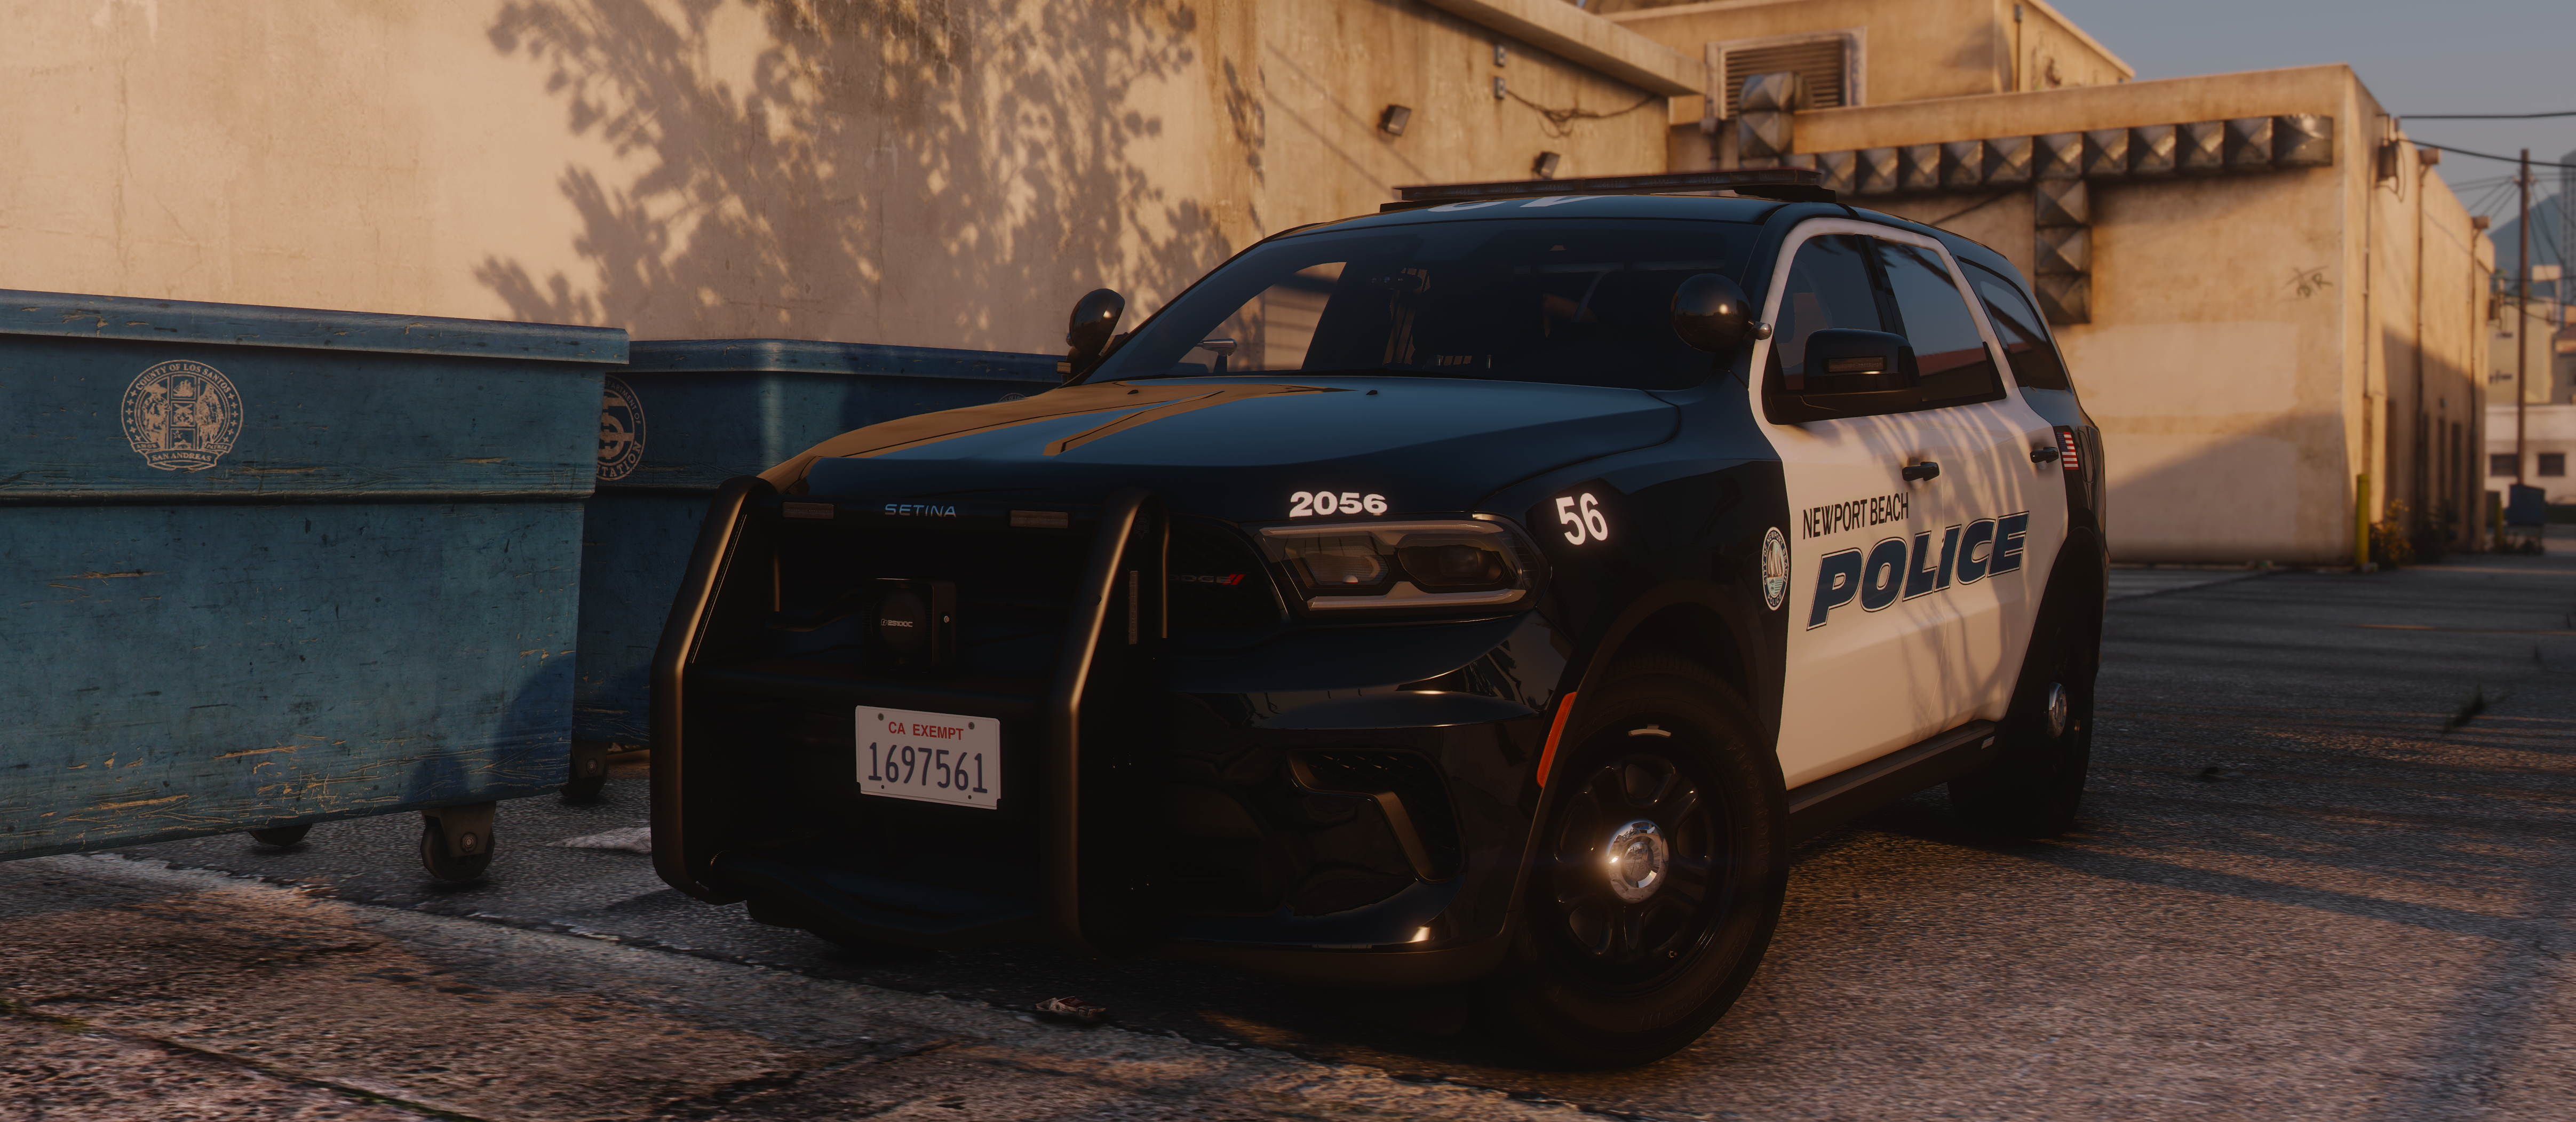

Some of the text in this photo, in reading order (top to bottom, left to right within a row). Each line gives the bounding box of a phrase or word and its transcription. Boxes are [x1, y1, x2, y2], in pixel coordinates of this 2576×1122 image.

[136, 366, 166, 390] COUNTY
[184, 364, 201, 372] LOS
[202, 368, 231, 393] SANTOS
[604, 380, 641, 424] EPARTMENT OF
[152, 452, 212, 461] SAN ANDREAS
[597, 441, 642, 477] ITATION
[885, 504, 957, 518] SETINA
[1289, 491, 1388, 517] 2056
[1803, 492, 1909, 539] NEWPORT BEACH
[1555, 492, 1608, 545] 56
[1764, 544, 1768, 558] OF
[1767, 531, 1783, 545] NEWPORT
[1169, 575, 1231, 584] ODGE
[1806, 511, 2029, 631] POLICE
[1767, 592, 1782, 606] POLICE
[888, 721, 964, 740] CA EXEMPT
[869, 742, 988, 793] 1697561
